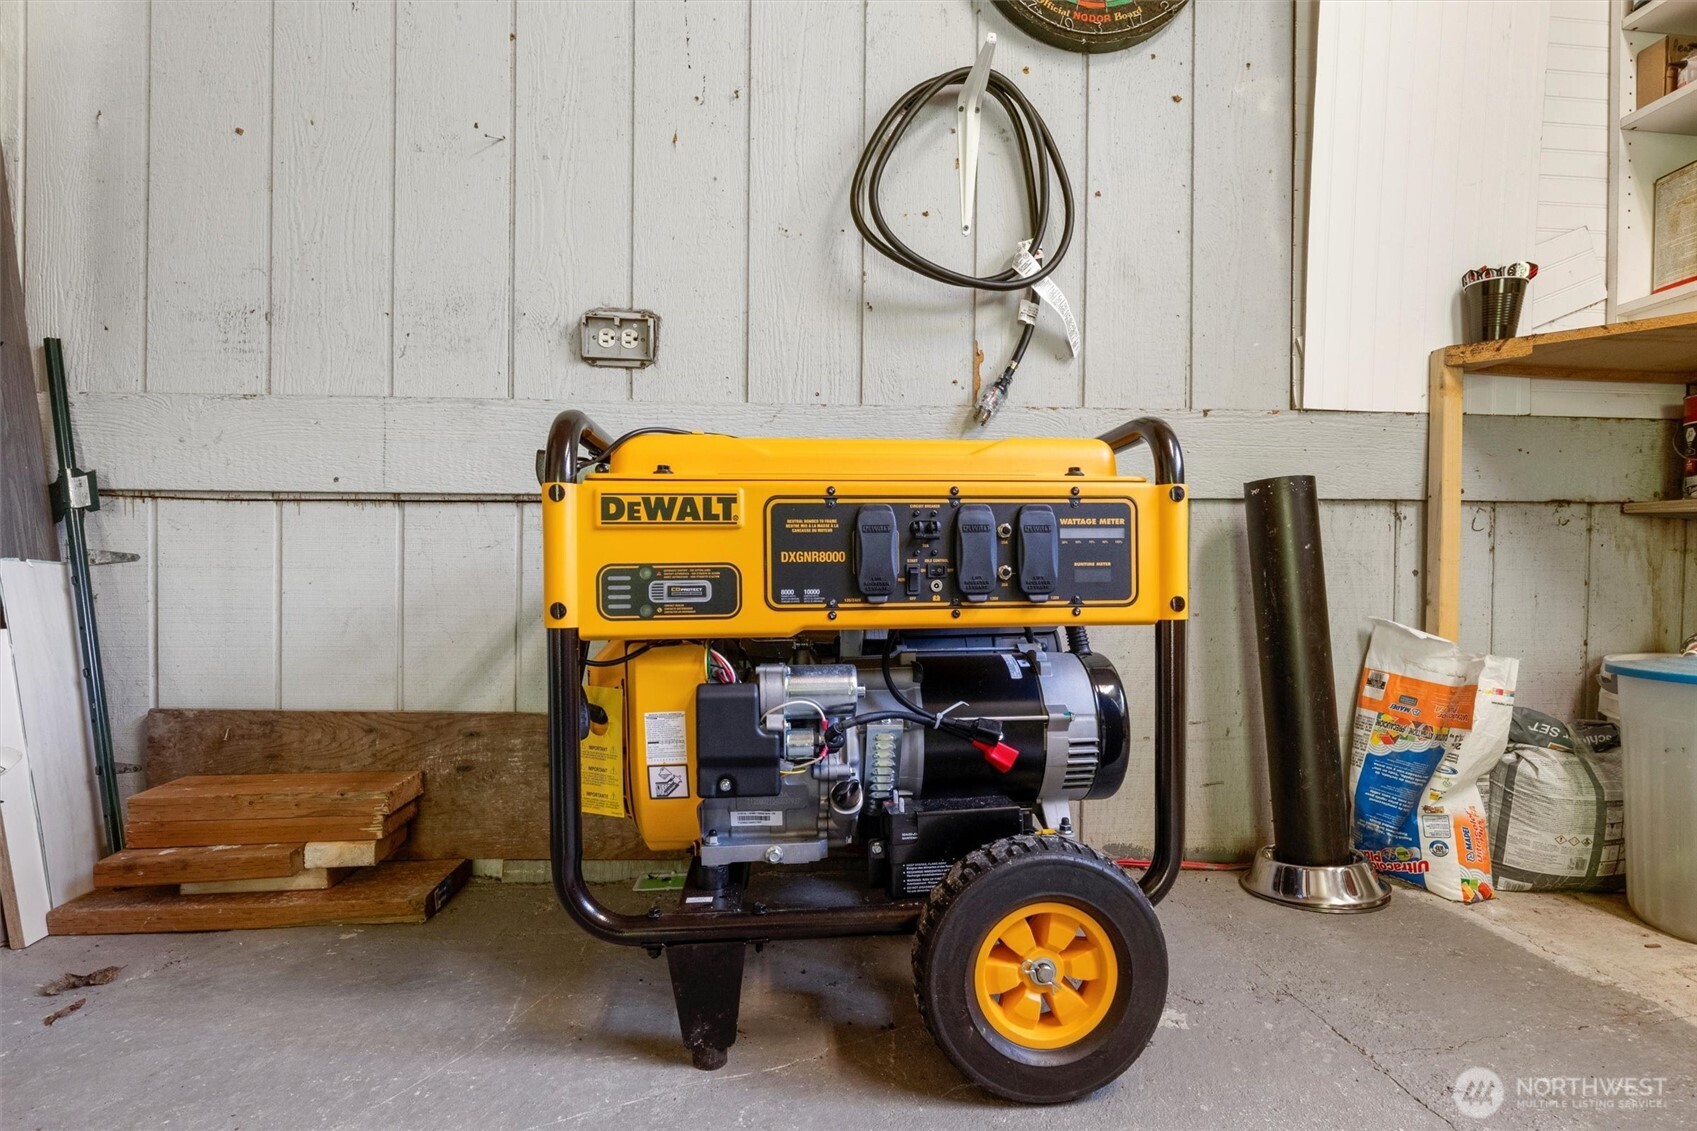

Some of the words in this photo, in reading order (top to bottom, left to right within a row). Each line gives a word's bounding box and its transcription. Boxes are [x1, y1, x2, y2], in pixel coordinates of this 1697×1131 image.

[1073, 13, 1112, 23] NODOR
[1114, 6, 1143, 21] Board
[1060, 16, 1074, 30] 19
[1095, 22, 1103, 33] 3
[601, 497, 738, 521] DEWALT
[781, 552, 845, 562] DXGNR8000
[1390, 704, 1411, 713] MAPEI
[1527, 722, 1560, 738] SET
[1462, 826, 1472, 850] MAPEI
[1370, 860, 1429, 874] Ultracolo
